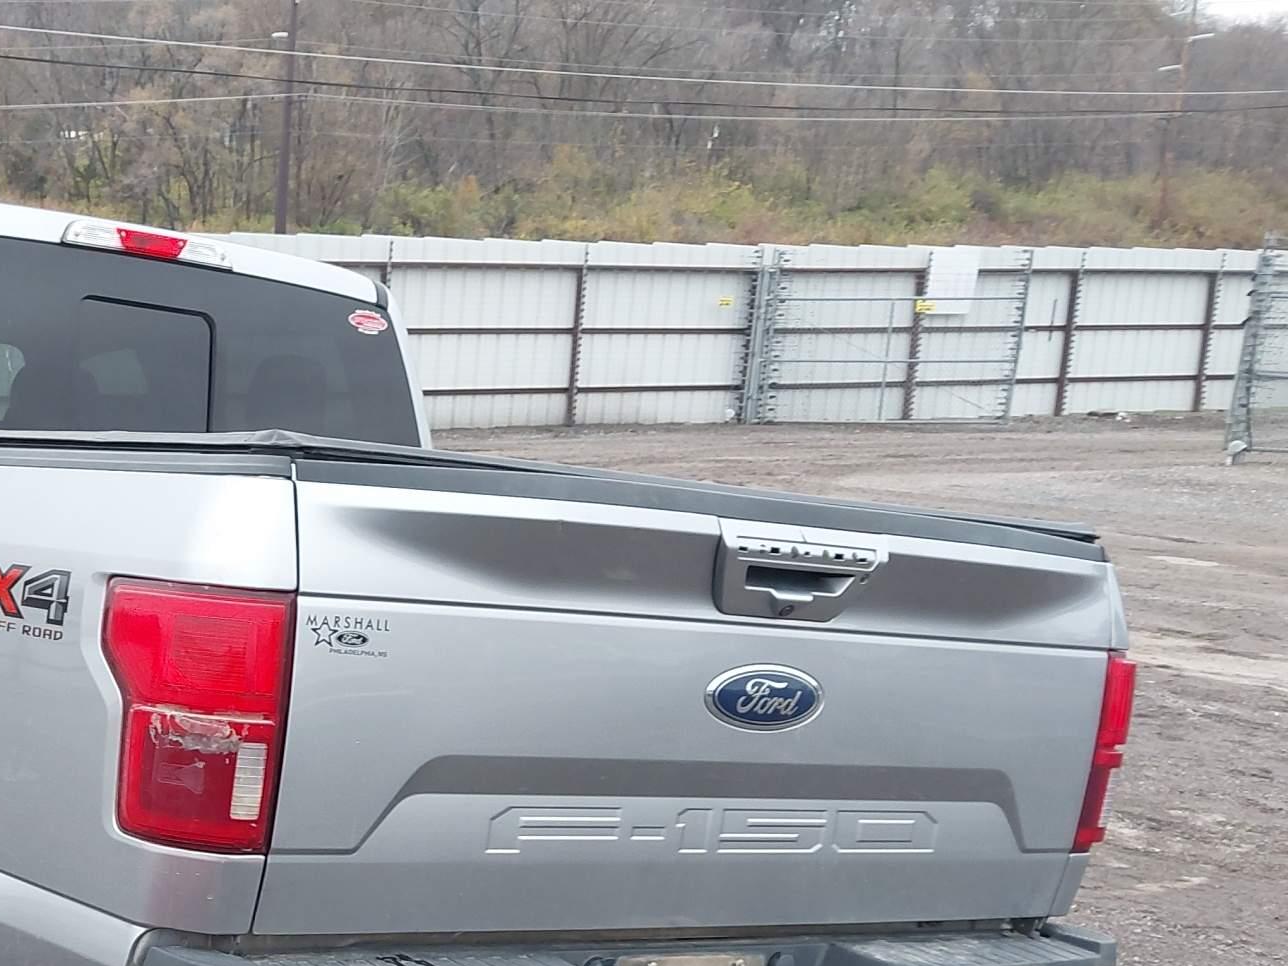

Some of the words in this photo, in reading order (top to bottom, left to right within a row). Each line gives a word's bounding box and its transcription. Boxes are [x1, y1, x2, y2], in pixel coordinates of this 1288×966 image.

[22, 624, 64, 641] ROAD
[306, 615, 390, 631] MARSHALL
[736, 678, 803, 716] Ford
[485, 806, 939, 854] F-150
